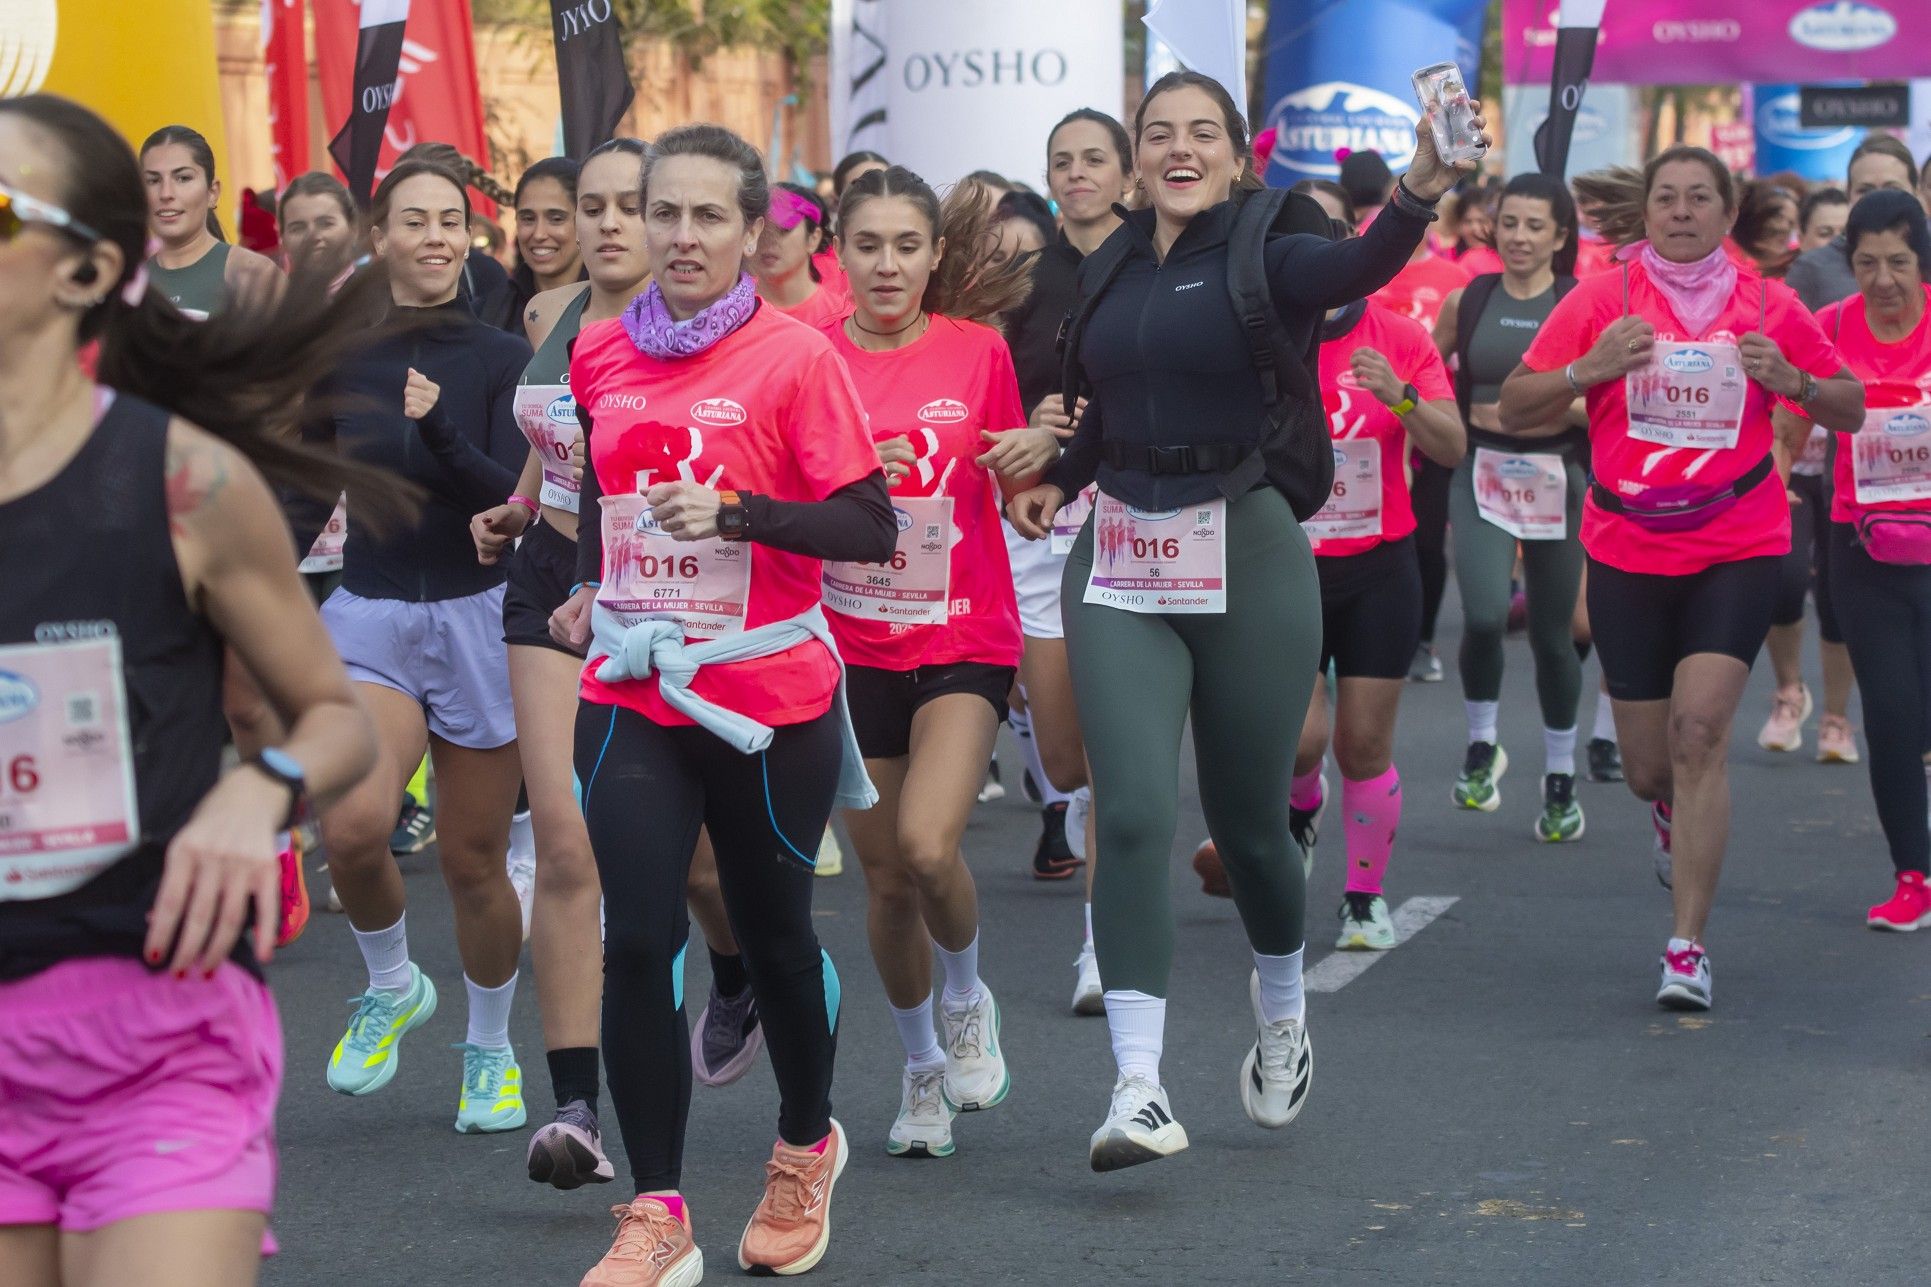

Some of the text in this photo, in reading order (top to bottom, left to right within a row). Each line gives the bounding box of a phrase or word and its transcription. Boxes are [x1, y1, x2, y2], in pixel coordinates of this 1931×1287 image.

[904, 50, 1067, 93] OYSHO
[362, 82, 393, 113] OYS
[1278, 118, 1415, 154] ASTURIANA
[1175, 281, 1204, 292] OYSHO
[1500, 317, 1538, 329] OYSHO
[1669, 358, 1710, 367] ASTURIANA
[1667, 386, 1709, 403] 016
[521, 409, 543, 417] SUMA
[694, 405, 742, 421] ASTURIANA
[922, 409, 965, 418] ASTURIANA
[1676, 410, 1696, 418] 2551
[1641, 427, 1673, 439] OYSHO
[1890, 446, 1929, 463] 016
[548, 489, 571, 505] OYSHO
[1502, 489, 1535, 503] 016
[1103, 505, 1123, 513] SUMA
[1133, 538, 1180, 559] 016
[640, 555, 699, 579] 016
[1149, 568, 1160, 577] 56
[830, 578, 854, 592] CARRERA
[865, 587, 873, 595] LA
[875, 589, 897, 598] MUJER
[866, 575, 892, 587] 3645
[1110, 580, 1136, 588] CARRERA
[1136, 580, 1144, 588] DE
[1144, 580, 1152, 588] LA
[653, 588, 681, 598] 6771
[1101, 591, 1209, 605] OYSHO Santander
[641, 602, 651, 610] DE
[652, 602, 662, 610] LA
[663, 602, 688, 610] MUJER
[695, 603, 724, 612] SEVILLA
[827, 591, 931, 616] OYSHO Santander
[34, 619, 118, 642] OYSHO
